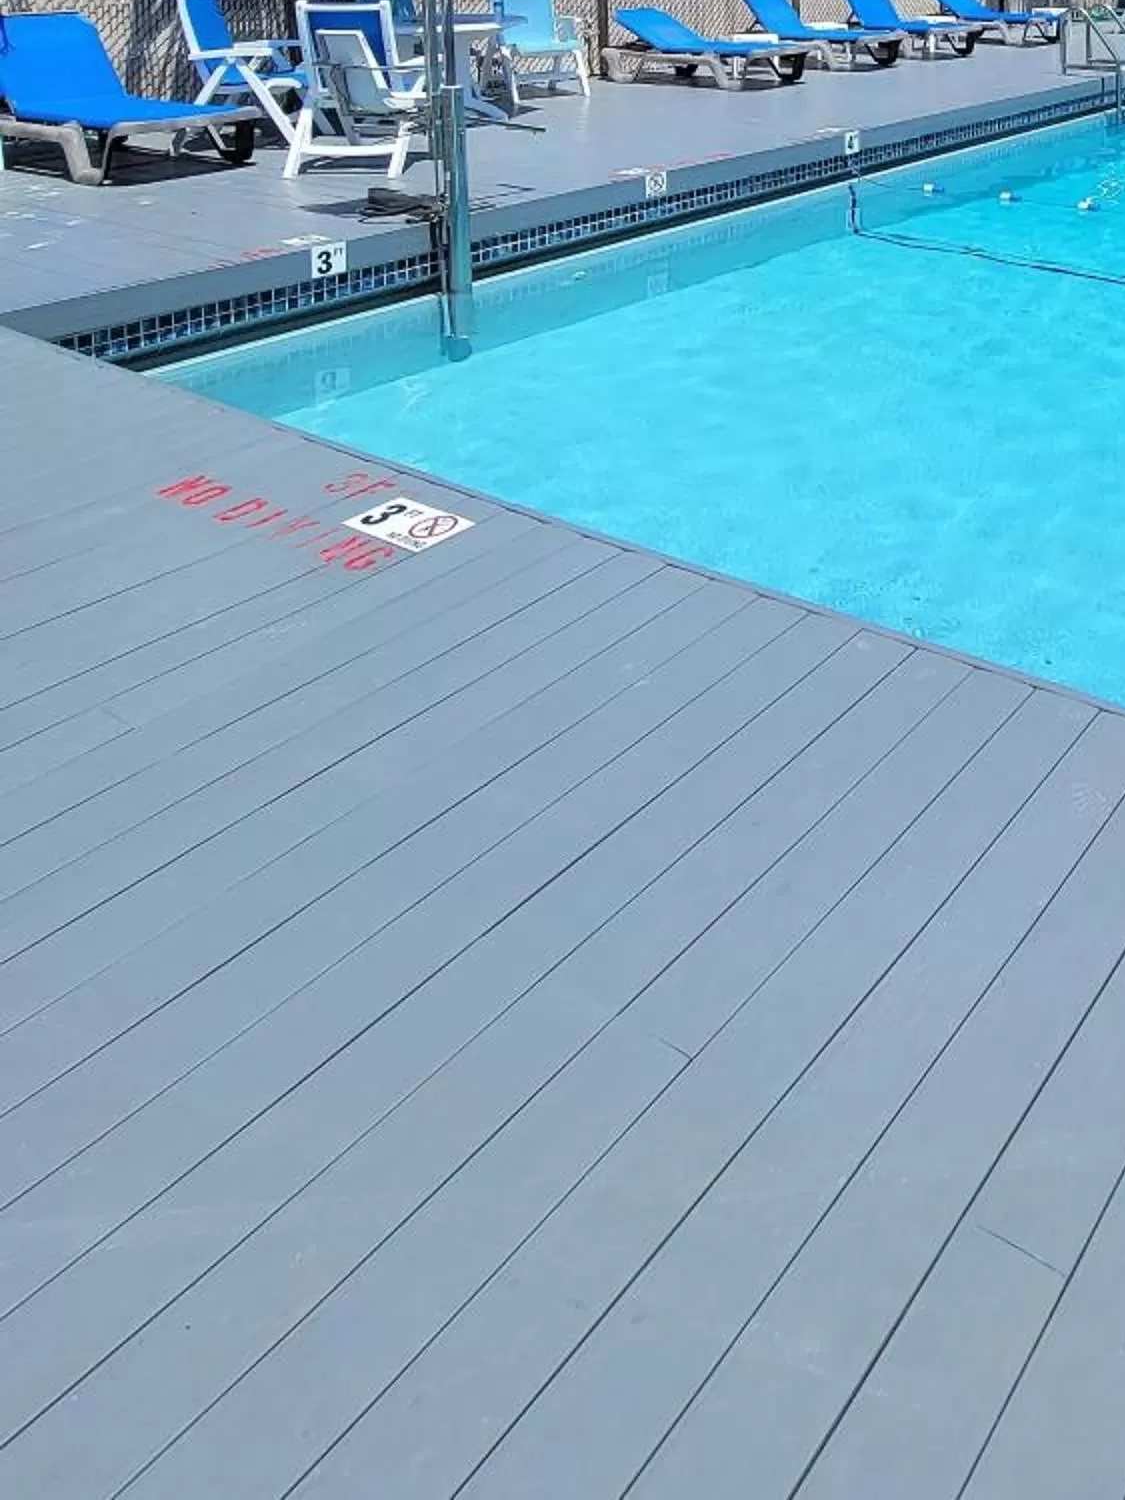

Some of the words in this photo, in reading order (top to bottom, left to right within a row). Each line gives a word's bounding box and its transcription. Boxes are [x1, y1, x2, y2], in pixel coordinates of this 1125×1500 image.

[317, 251, 333, 274] 3
[157, 474, 233, 507] NO
[211, 498, 396, 571] DIVING
[360, 504, 407, 525] 3
